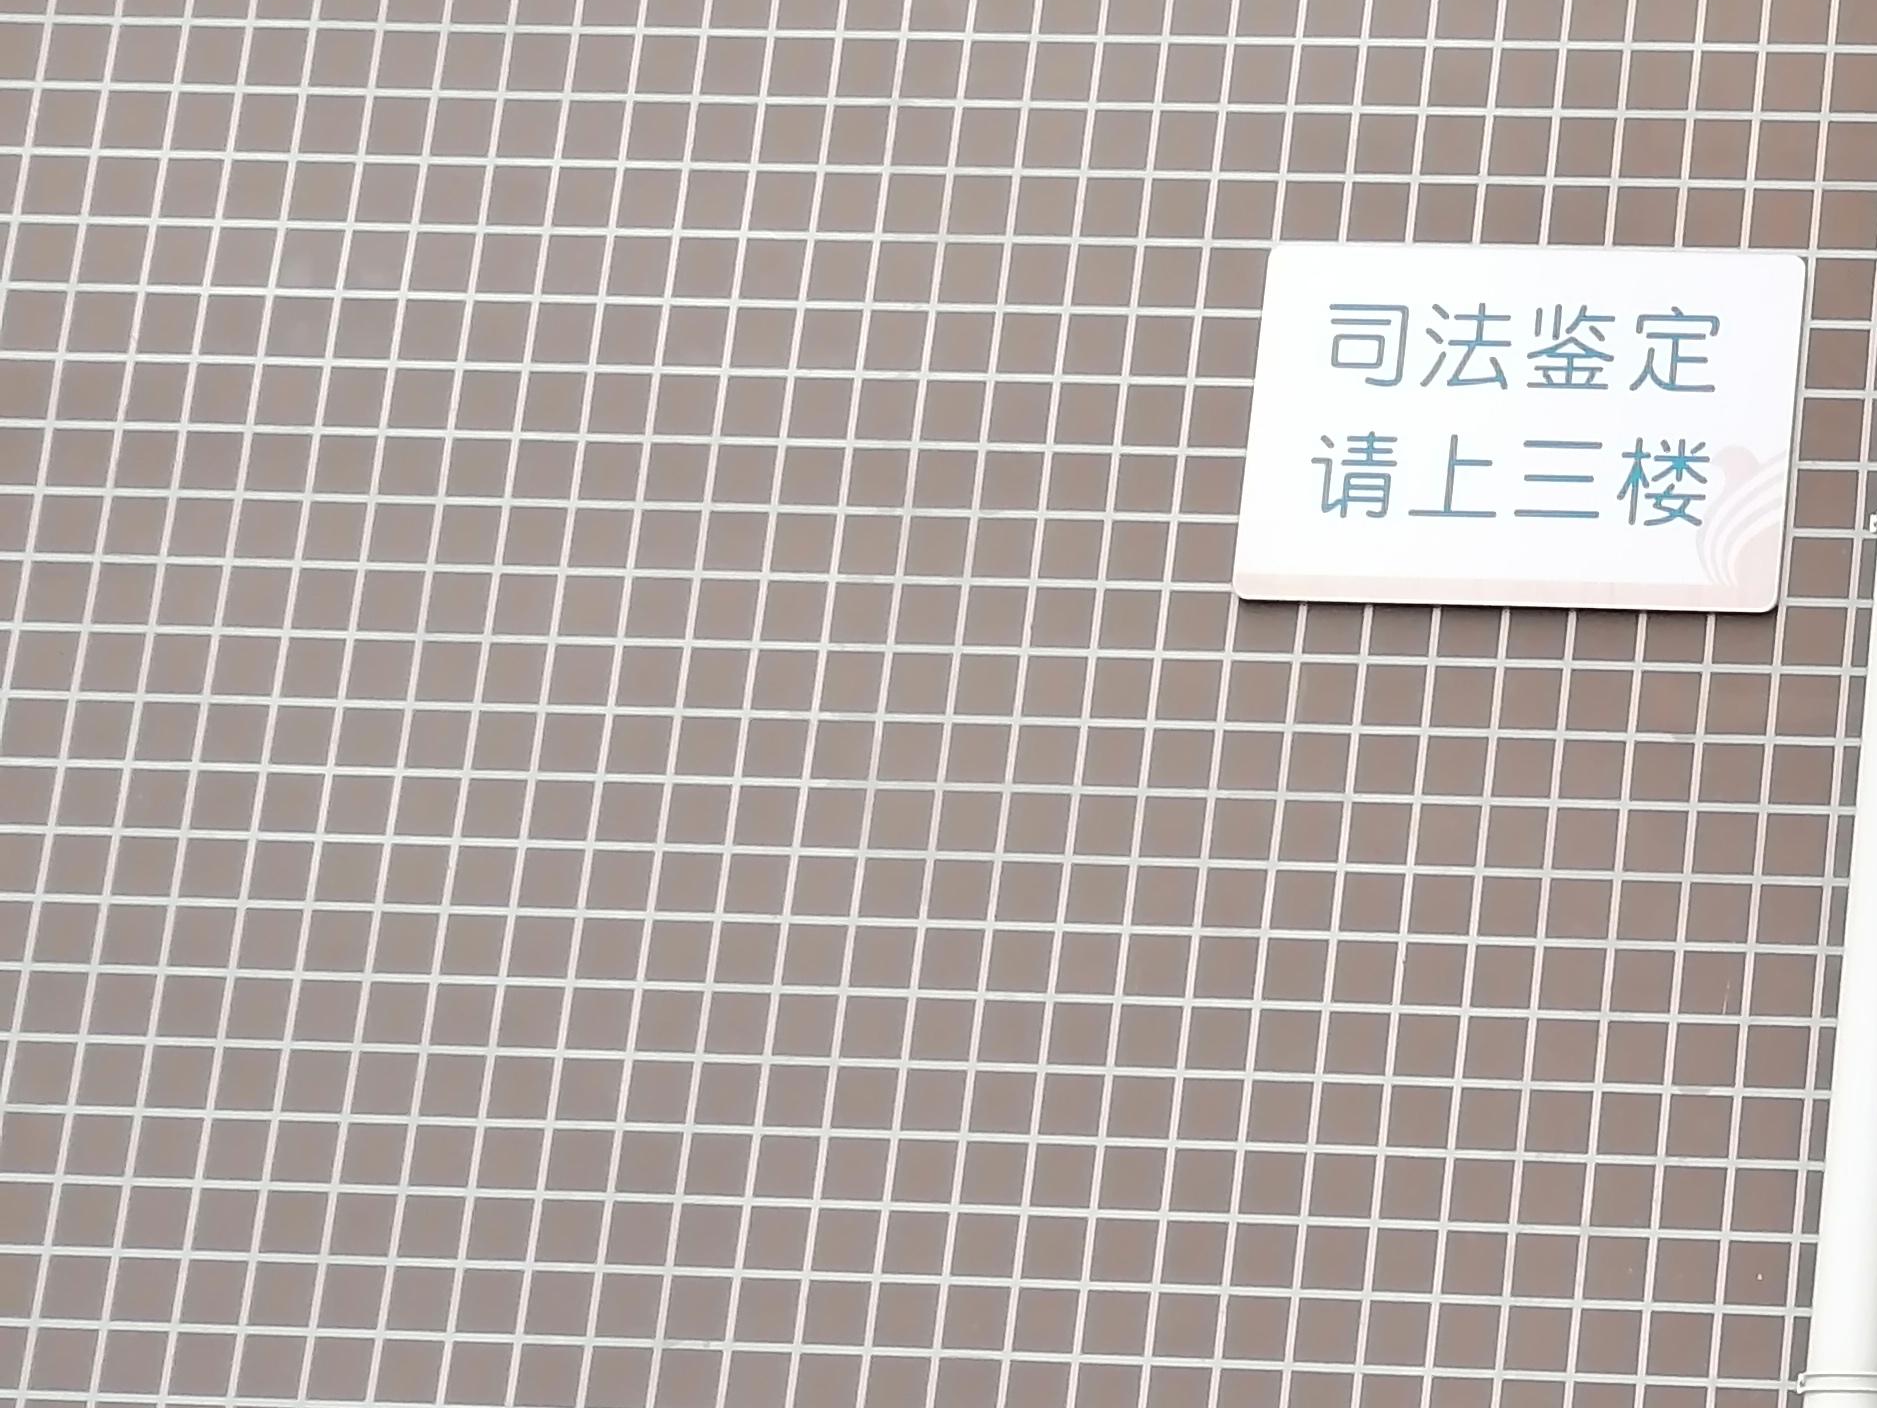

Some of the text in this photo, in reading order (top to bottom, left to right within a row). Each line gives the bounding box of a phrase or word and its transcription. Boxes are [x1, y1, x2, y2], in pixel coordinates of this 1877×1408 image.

[1328, 302, 1721, 393] 司法鉴定
[1310, 430, 1711, 527] 请上三楼
